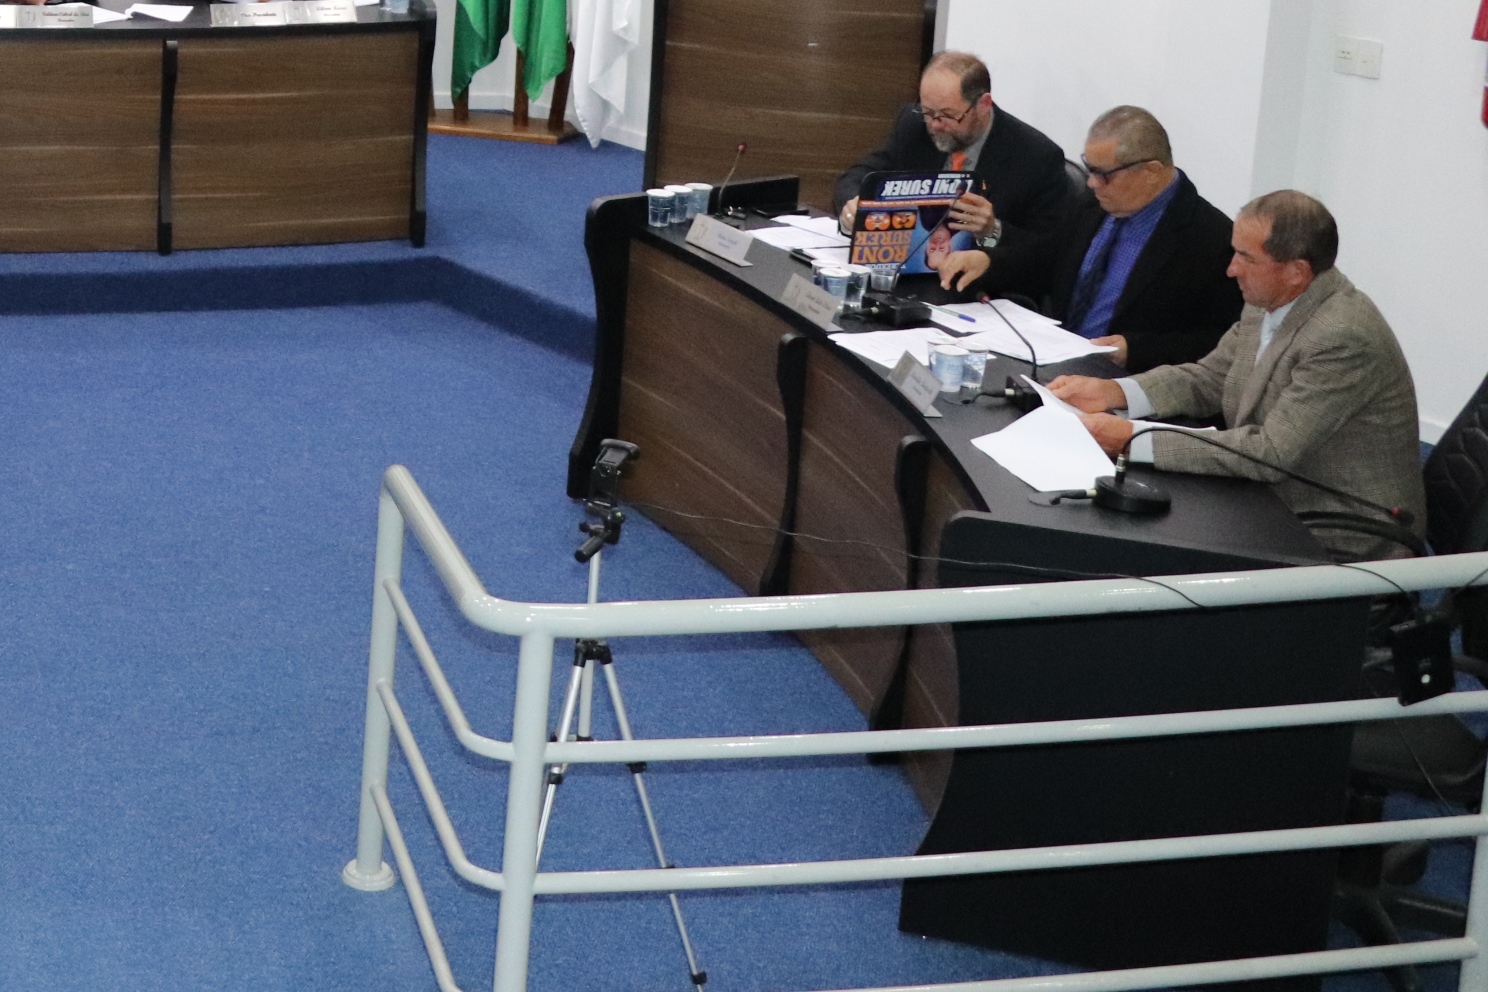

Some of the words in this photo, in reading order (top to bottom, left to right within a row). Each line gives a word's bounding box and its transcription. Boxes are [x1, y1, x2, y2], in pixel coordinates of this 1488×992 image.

[880, 179, 932, 196] SUREK
[855, 230, 913, 246] SUREK
[852, 245, 909, 264] RONI
